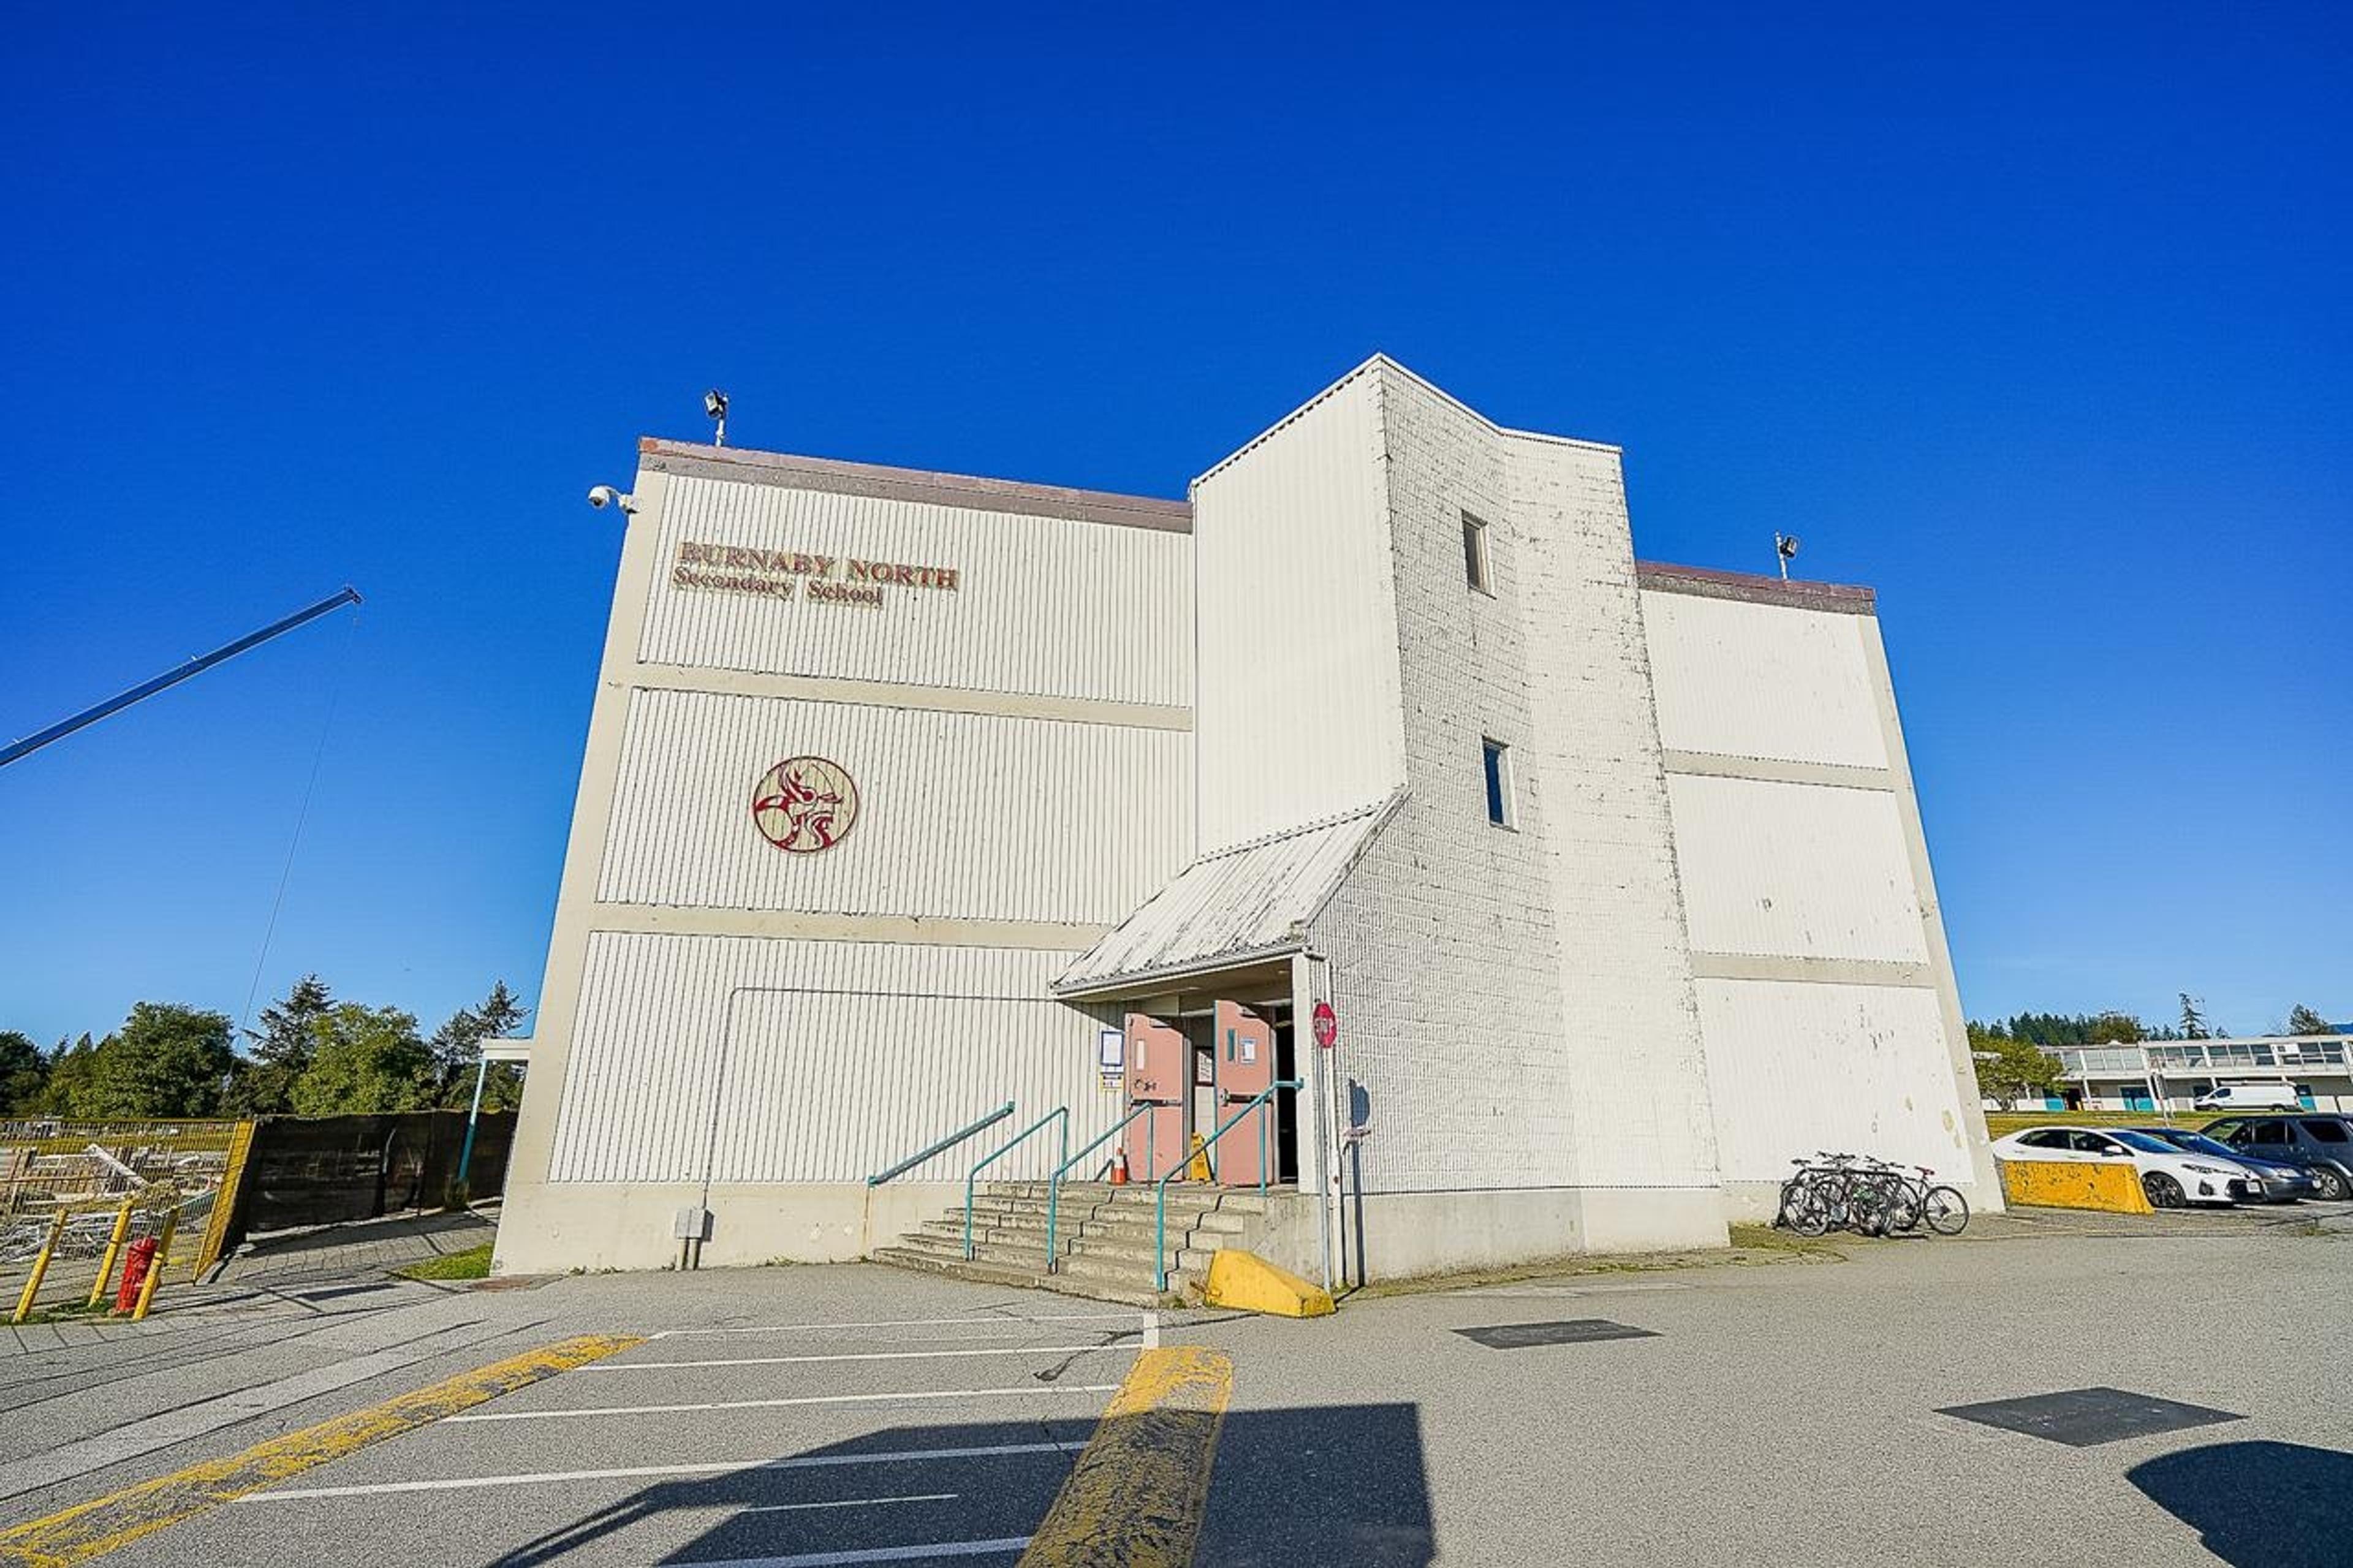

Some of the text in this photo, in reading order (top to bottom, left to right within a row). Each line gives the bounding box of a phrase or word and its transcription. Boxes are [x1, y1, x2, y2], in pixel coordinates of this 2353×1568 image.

[673, 565, 882, 605] Secondary School
[680, 542, 958, 590] BURNABY NORTH
